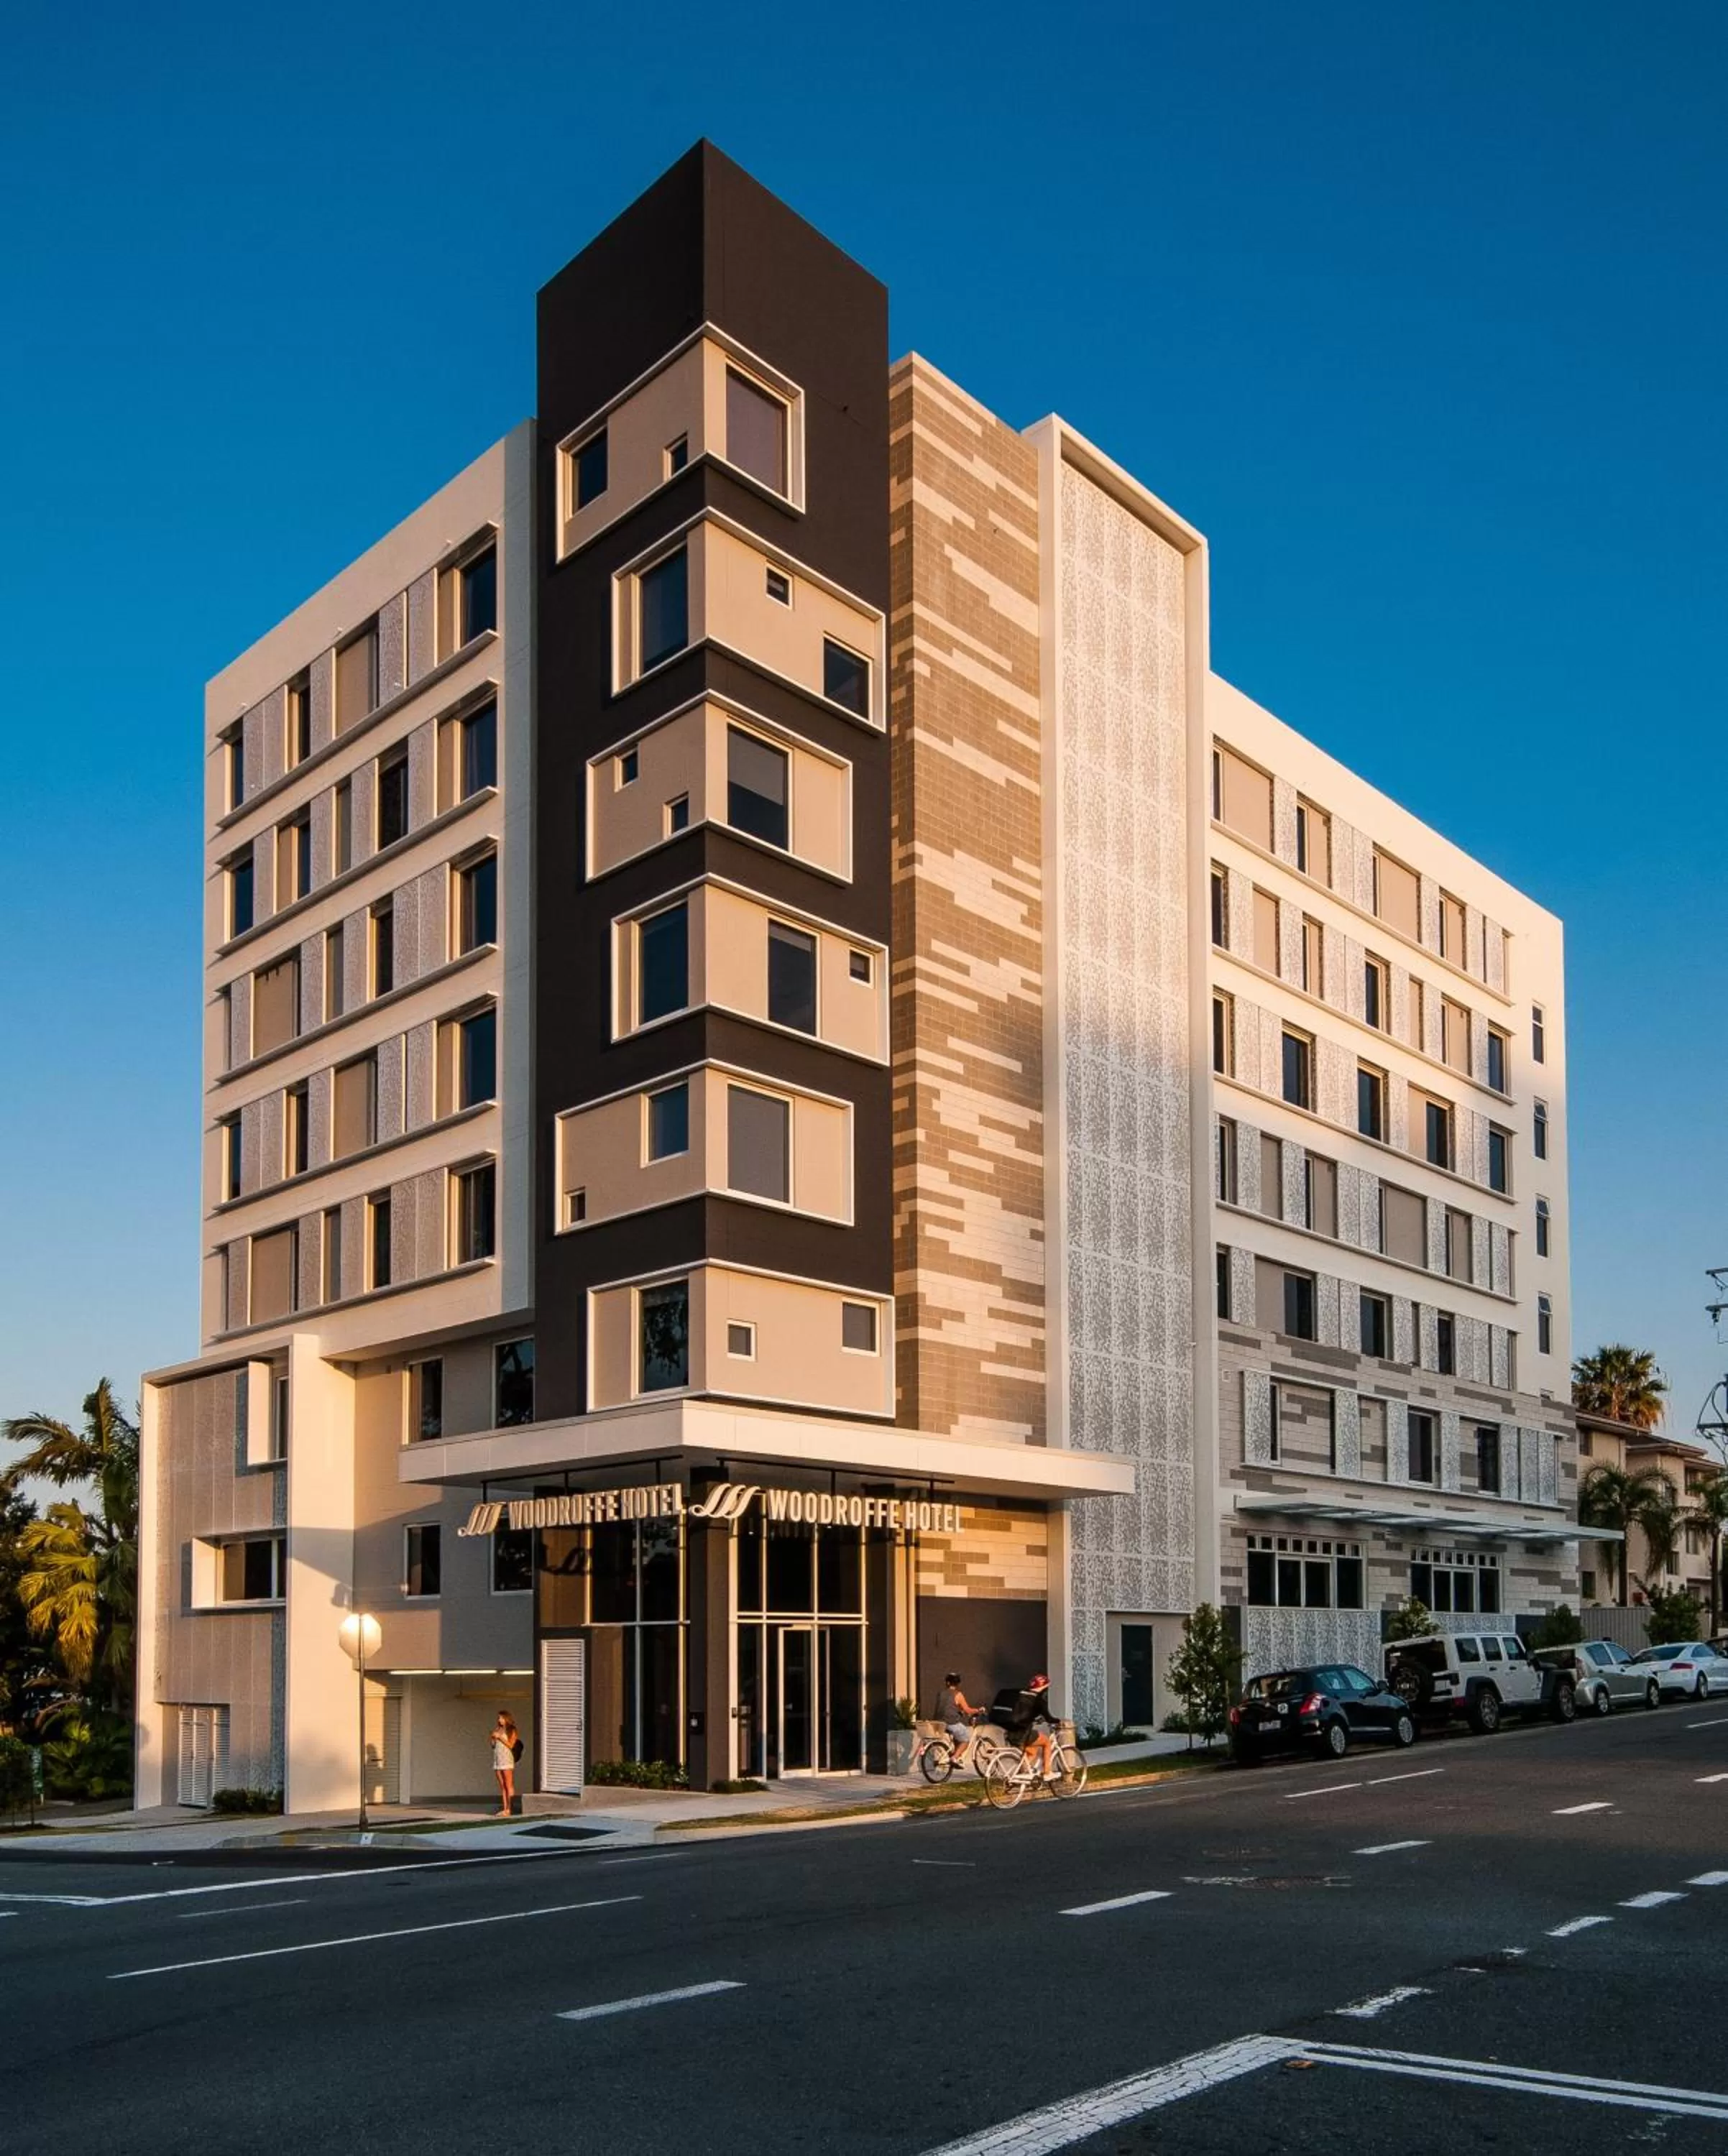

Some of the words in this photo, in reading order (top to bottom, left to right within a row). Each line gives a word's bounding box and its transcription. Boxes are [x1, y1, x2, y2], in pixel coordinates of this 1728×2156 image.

[508, 1490, 620, 1530] WOODROFFE
[621, 1483, 683, 1520] HOTEL
[768, 1488, 900, 1528] WOODROFFE
[902, 1501, 965, 1533] HOTEL
